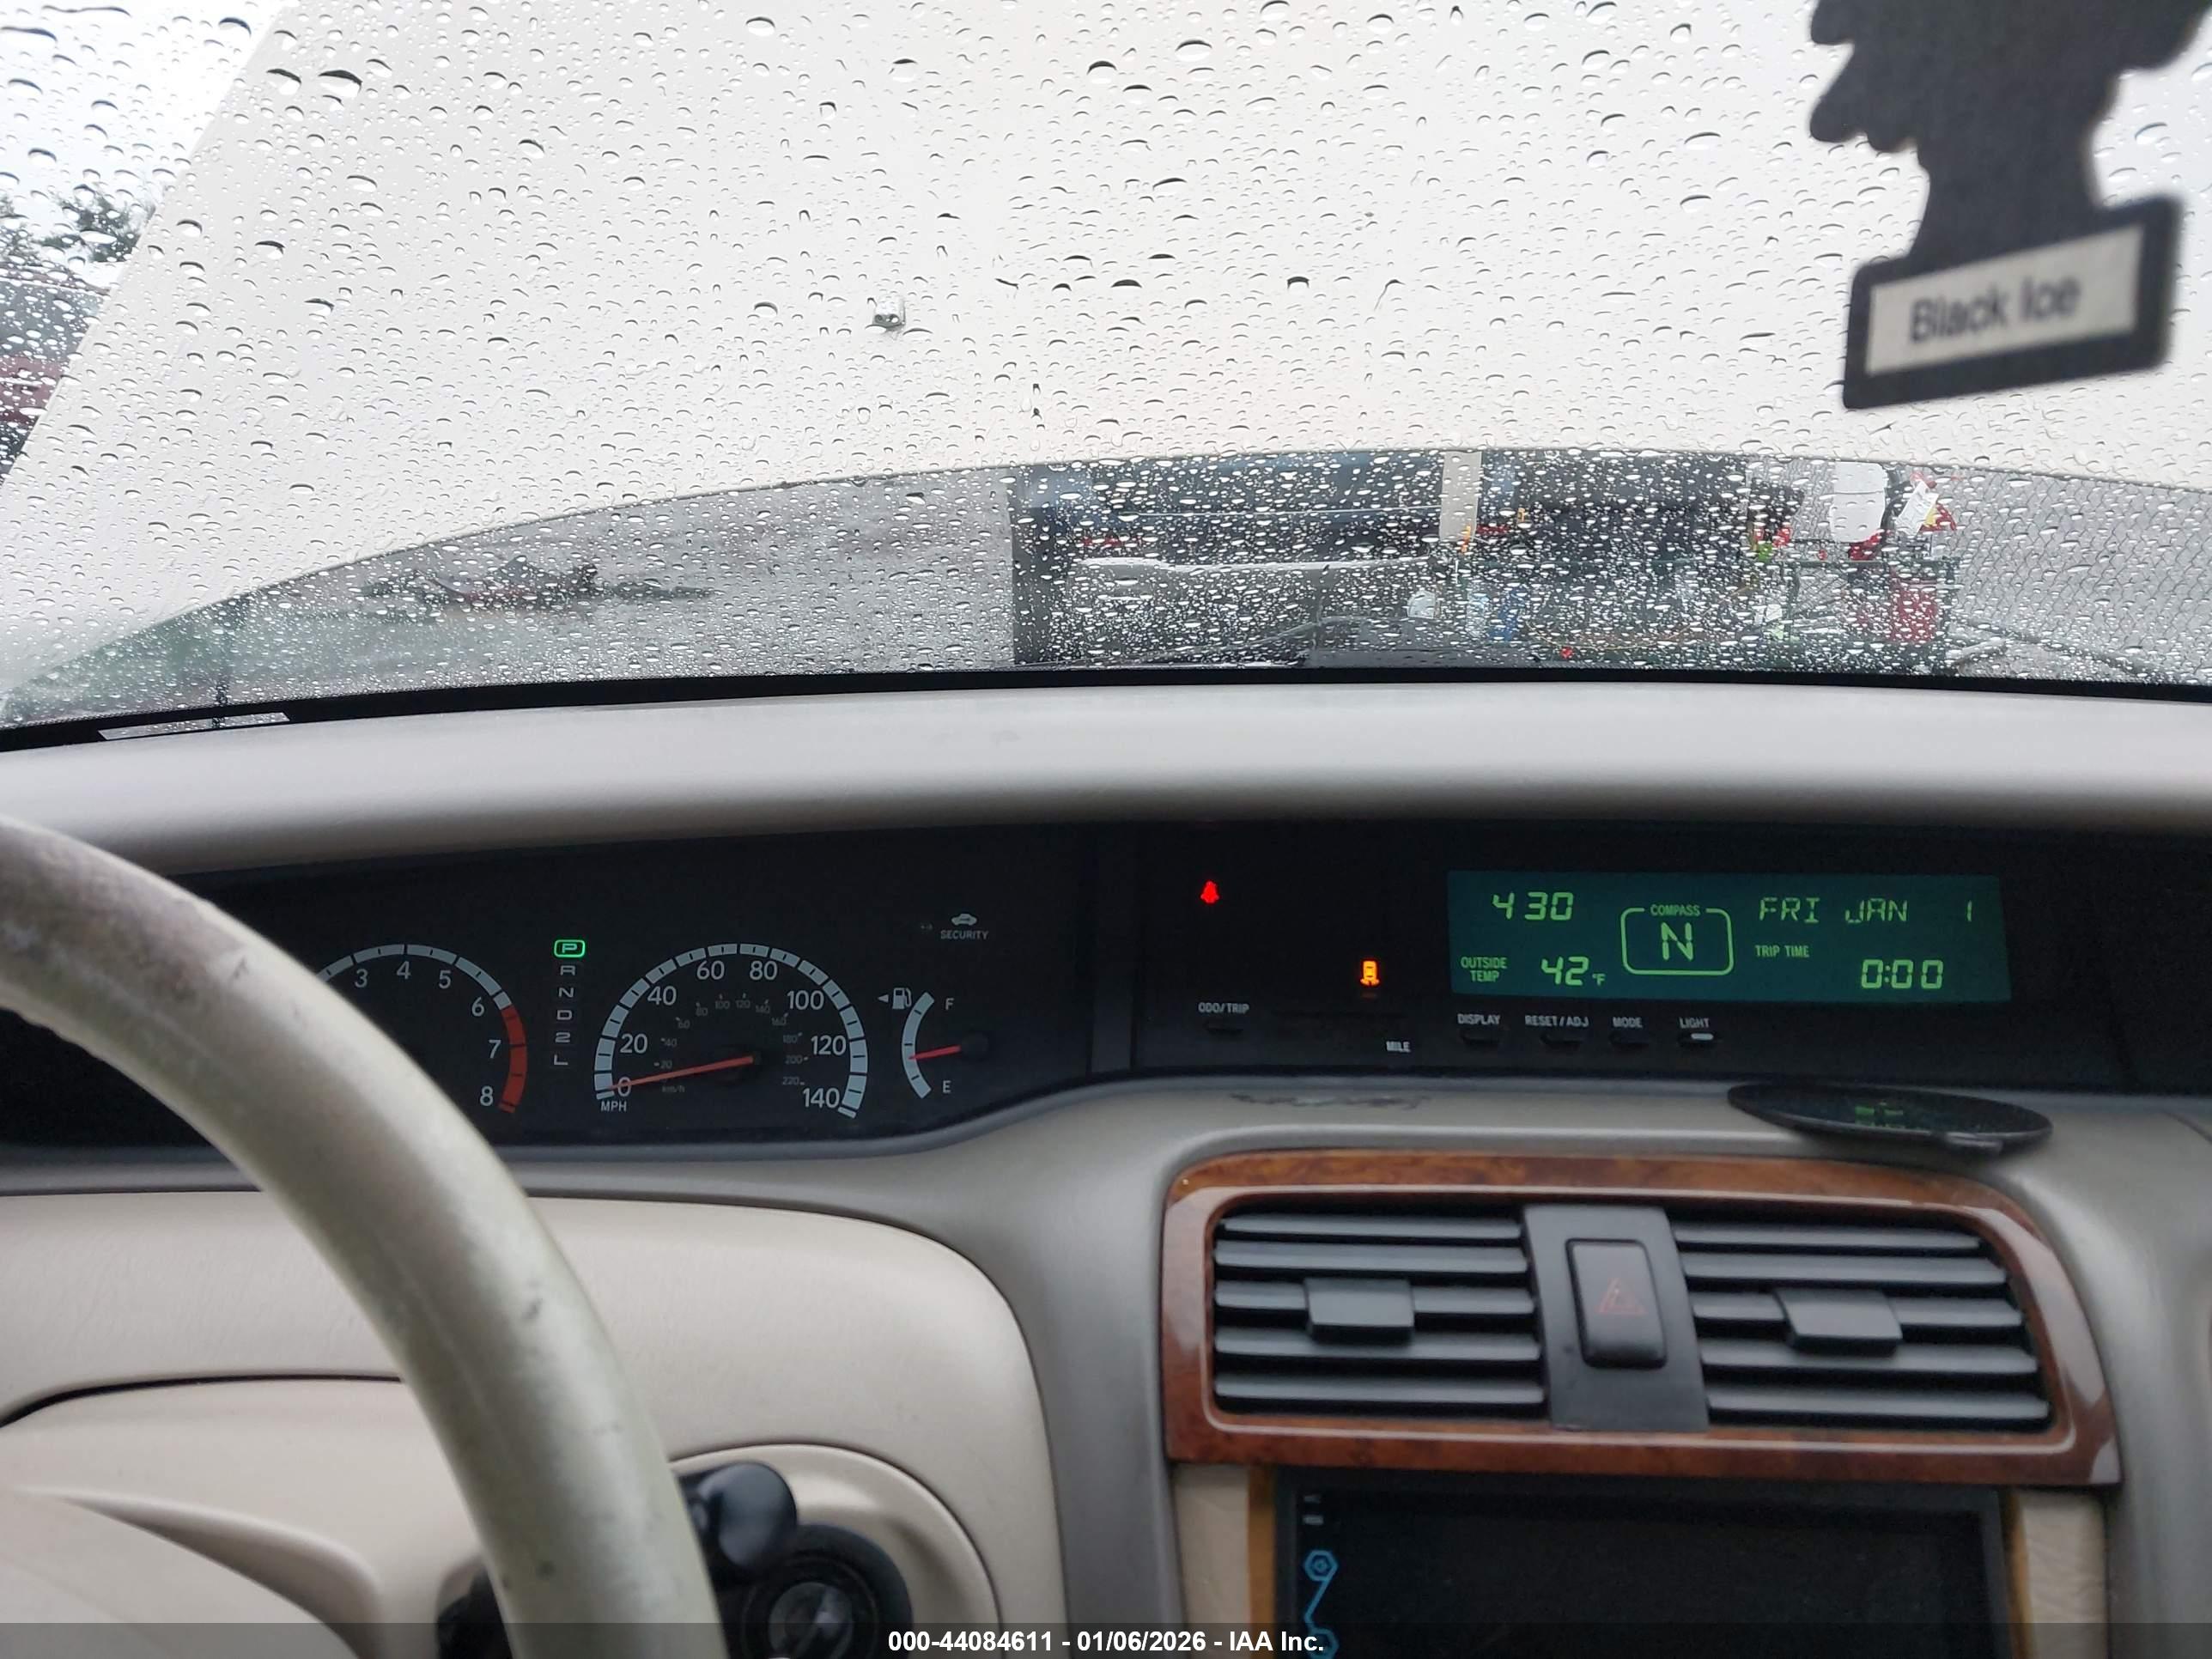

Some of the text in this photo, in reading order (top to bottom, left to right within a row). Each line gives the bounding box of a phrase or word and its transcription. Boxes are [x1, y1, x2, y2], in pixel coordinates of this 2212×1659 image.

[1911, 285, 2008, 343] Black
[1650, 904, 1700, 917] COMPASS
[1759, 897, 1972, 923] FRI JAN 1
[940, 930, 988, 940] SECURITY
[1661, 921, 1694, 961] N
[1755, 945, 1810, 958] TRIP TIME
[397, 961, 410, 980] 4
[696, 961, 725, 981] 60
[749, 961, 778, 981] 80
[1461, 957, 1508, 969] OUTSIDE
[1541, 957, 1589, 986] 42
[355, 969, 368, 988] 3
[439, 969, 451, 988] 5
[1470, 970, 1500, 982] TEMP
[1862, 959, 1943, 989] 0:00
[647, 986, 677, 1006] 40
[787, 990, 824, 1010] 100
[945, 998, 954, 1010] F
[472, 997, 484, 1017] 6
[1457, 1013, 1501, 1025] DISPLAY
[1613, 1017, 1643, 1028] MODE
[1679, 1017, 1710, 1029] LIGHT
[489, 1039, 501, 1059] 7
[620, 1034, 647, 1054] 20
[811, 1036, 847, 1055] 120
[618, 1077, 631, 1097] 0
[782, 1077, 799, 1085] 220
[943, 1080, 951, 1093] E
[480, 1085, 493, 1106] 8
[803, 1088, 840, 1108] 140
[601, 1101, 627, 1112] MPH
